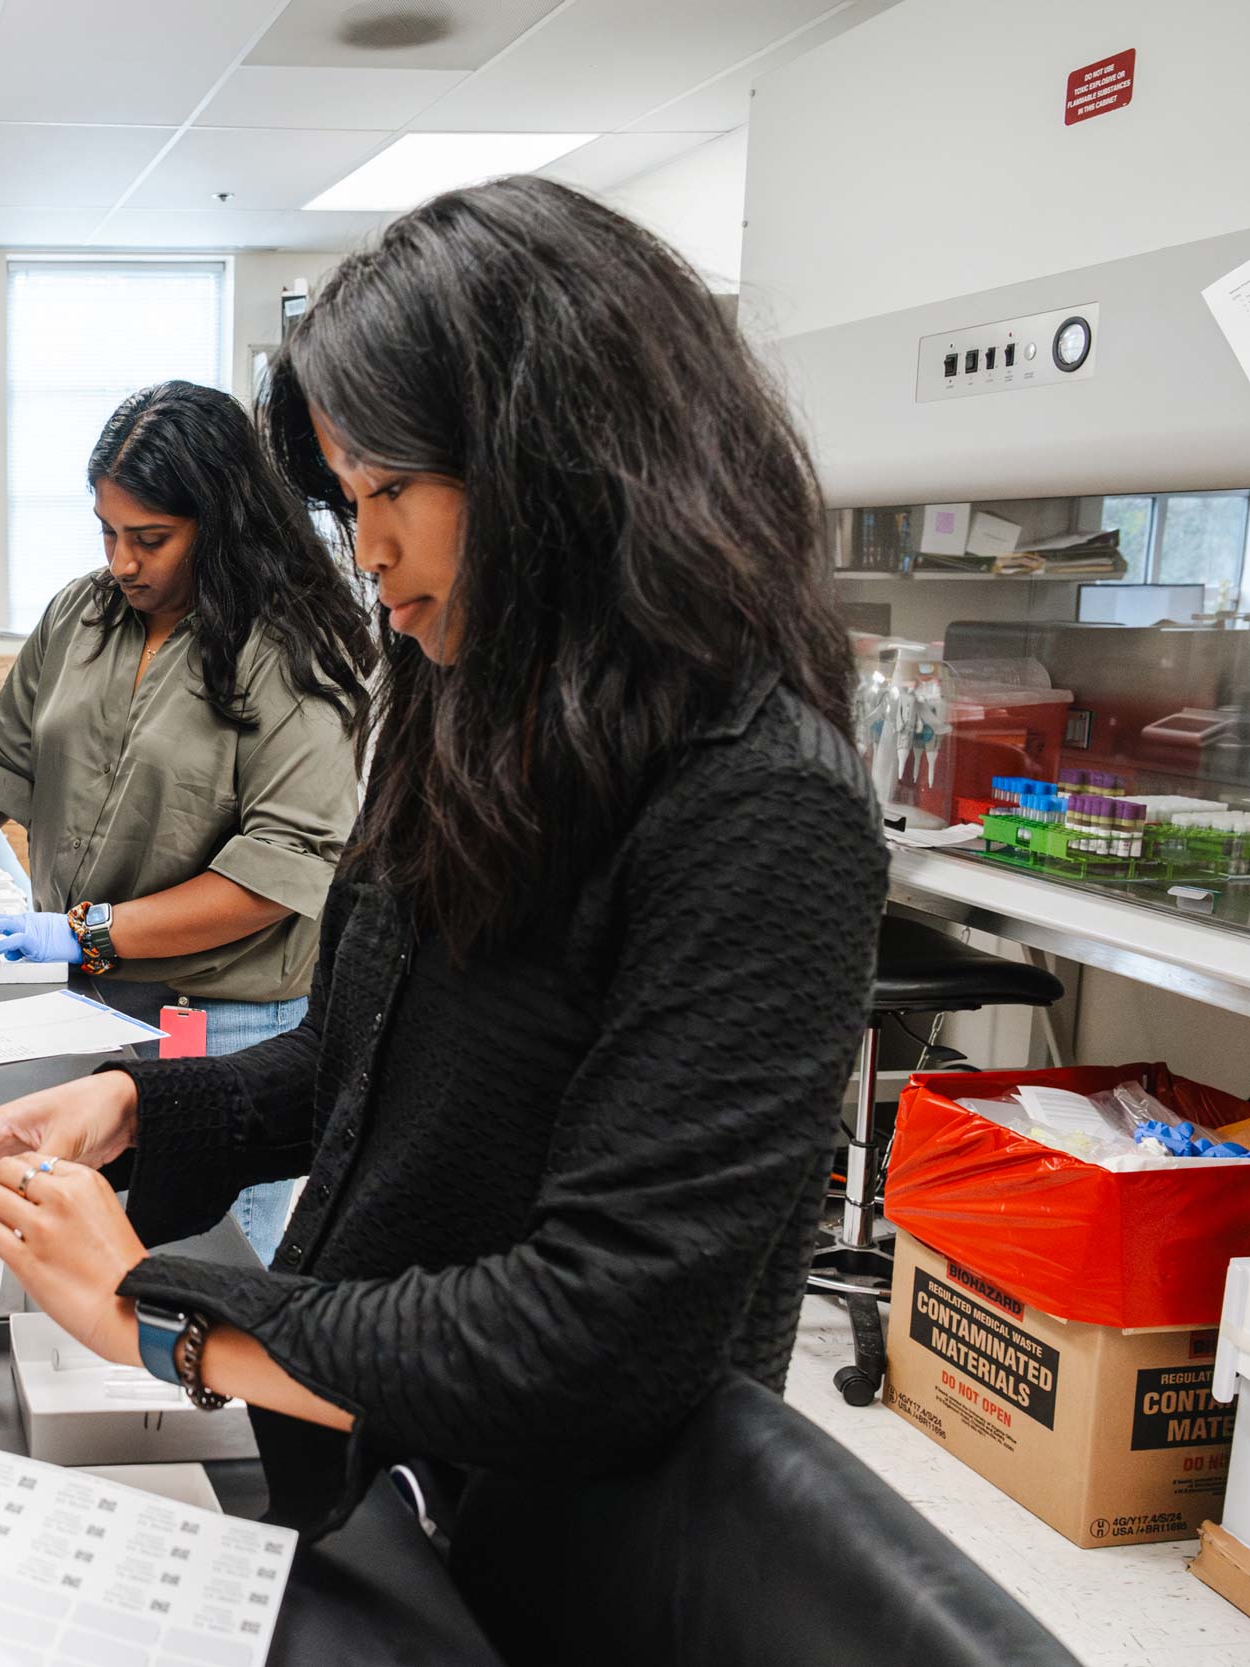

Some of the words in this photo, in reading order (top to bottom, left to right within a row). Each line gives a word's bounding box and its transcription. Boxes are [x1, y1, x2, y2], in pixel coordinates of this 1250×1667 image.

[929, 1281, 972, 1315] REGULATED
[973, 1308, 1010, 1338] MEDICAL
[1012, 1331, 1043, 1358] WASTE
[949, 1263, 1022, 1315] BIOHAZARD
[917, 1291, 1053, 1392] CONTAMINATED
[931, 1326, 1031, 1408] MATERIALS
[942, 1370, 956, 1389] DO
[958, 1380, 980, 1405] NOT
[982, 1397, 1012, 1428] OPEN
[1113, 1527, 1134, 1536] USA
